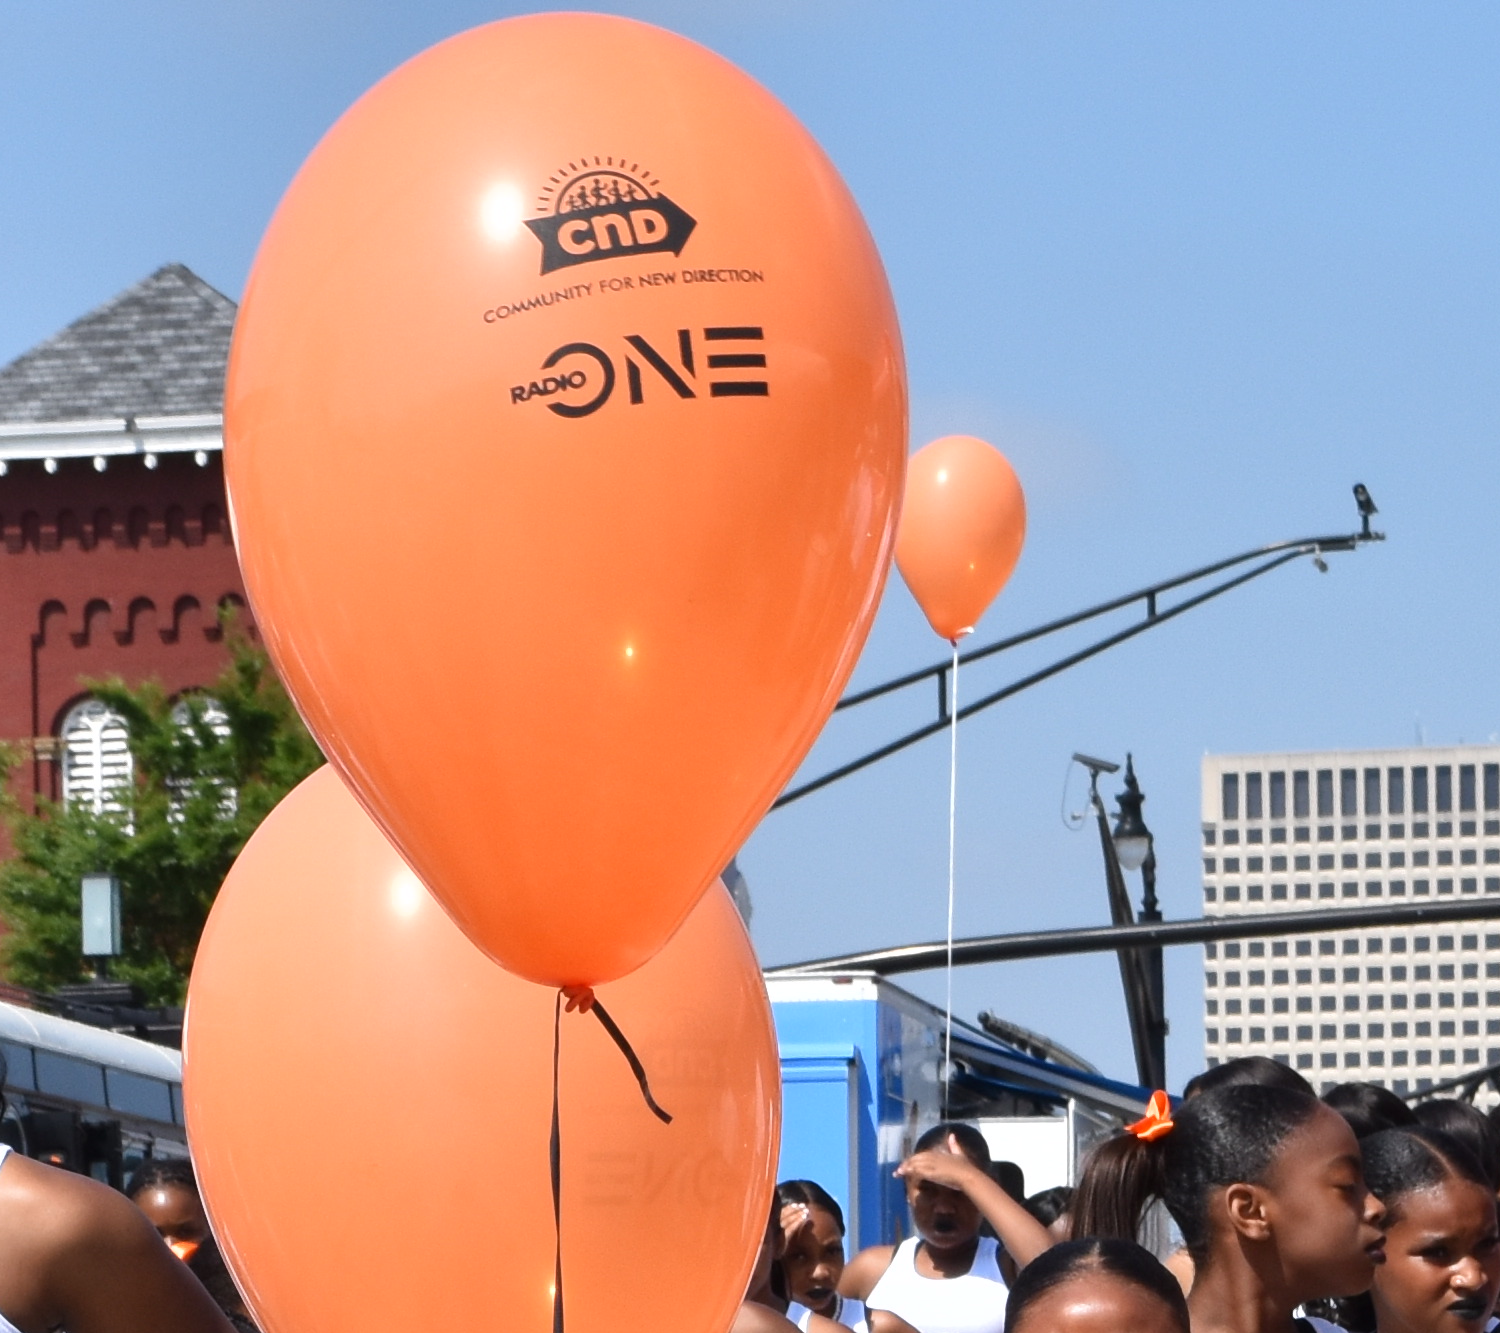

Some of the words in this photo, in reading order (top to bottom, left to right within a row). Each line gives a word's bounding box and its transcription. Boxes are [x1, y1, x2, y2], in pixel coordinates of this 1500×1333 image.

[483, 283, 592, 324] COMMUNITY
[599, 276, 635, 293] FOR
[638, 271, 677, 287] NEW
[681, 269, 764, 285] DIRECTION
[510, 370, 587, 404] RADIO
[540, 326, 769, 419] ONE
